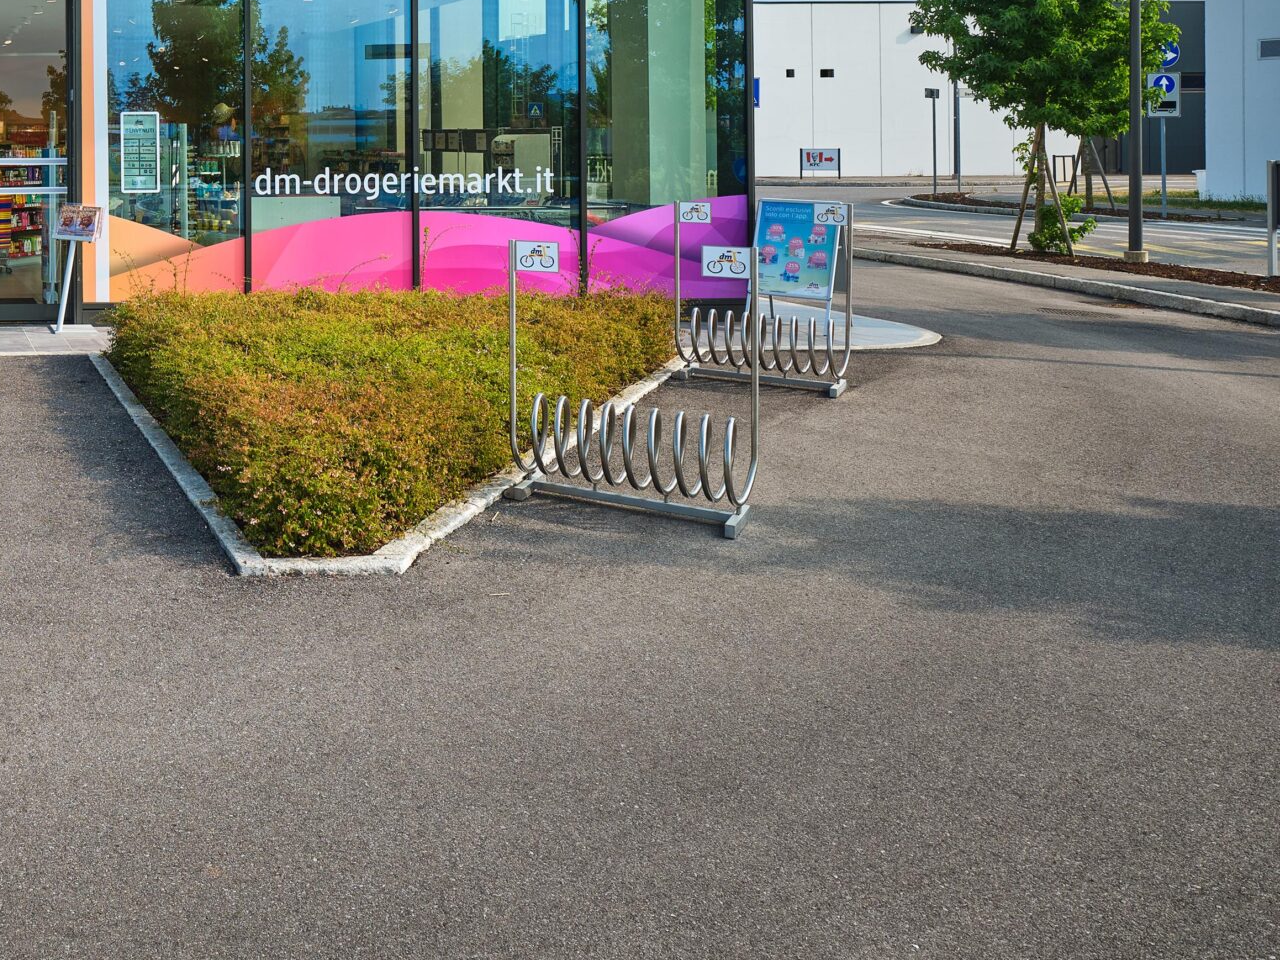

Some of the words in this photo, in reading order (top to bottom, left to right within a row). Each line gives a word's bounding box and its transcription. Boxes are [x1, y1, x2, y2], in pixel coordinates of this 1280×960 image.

[254, 166, 555, 202] dm-drogeriemarkt.it
[530, 247, 543, 255] dm
[719, 251, 733, 260] dm
